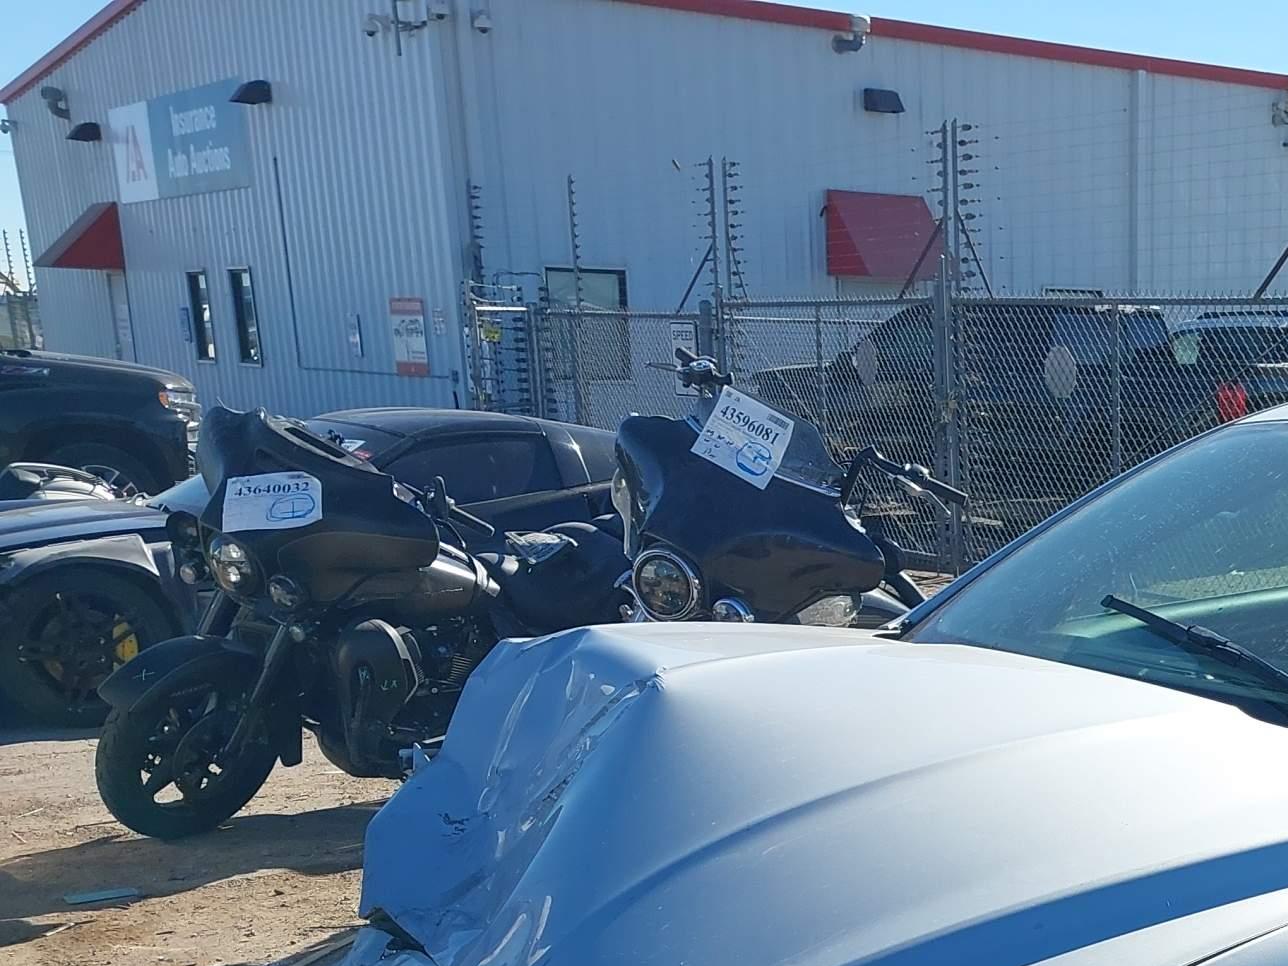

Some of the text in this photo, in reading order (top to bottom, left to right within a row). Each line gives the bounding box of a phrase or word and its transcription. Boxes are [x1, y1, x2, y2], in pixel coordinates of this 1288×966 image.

[168, 105, 217, 137] Insurance
[167, 140, 231, 179] Auto Auctions
[672, 329, 693, 341] SPEED
[720, 405, 780, 445] 43596081
[234, 481, 310, 497] 43640032
